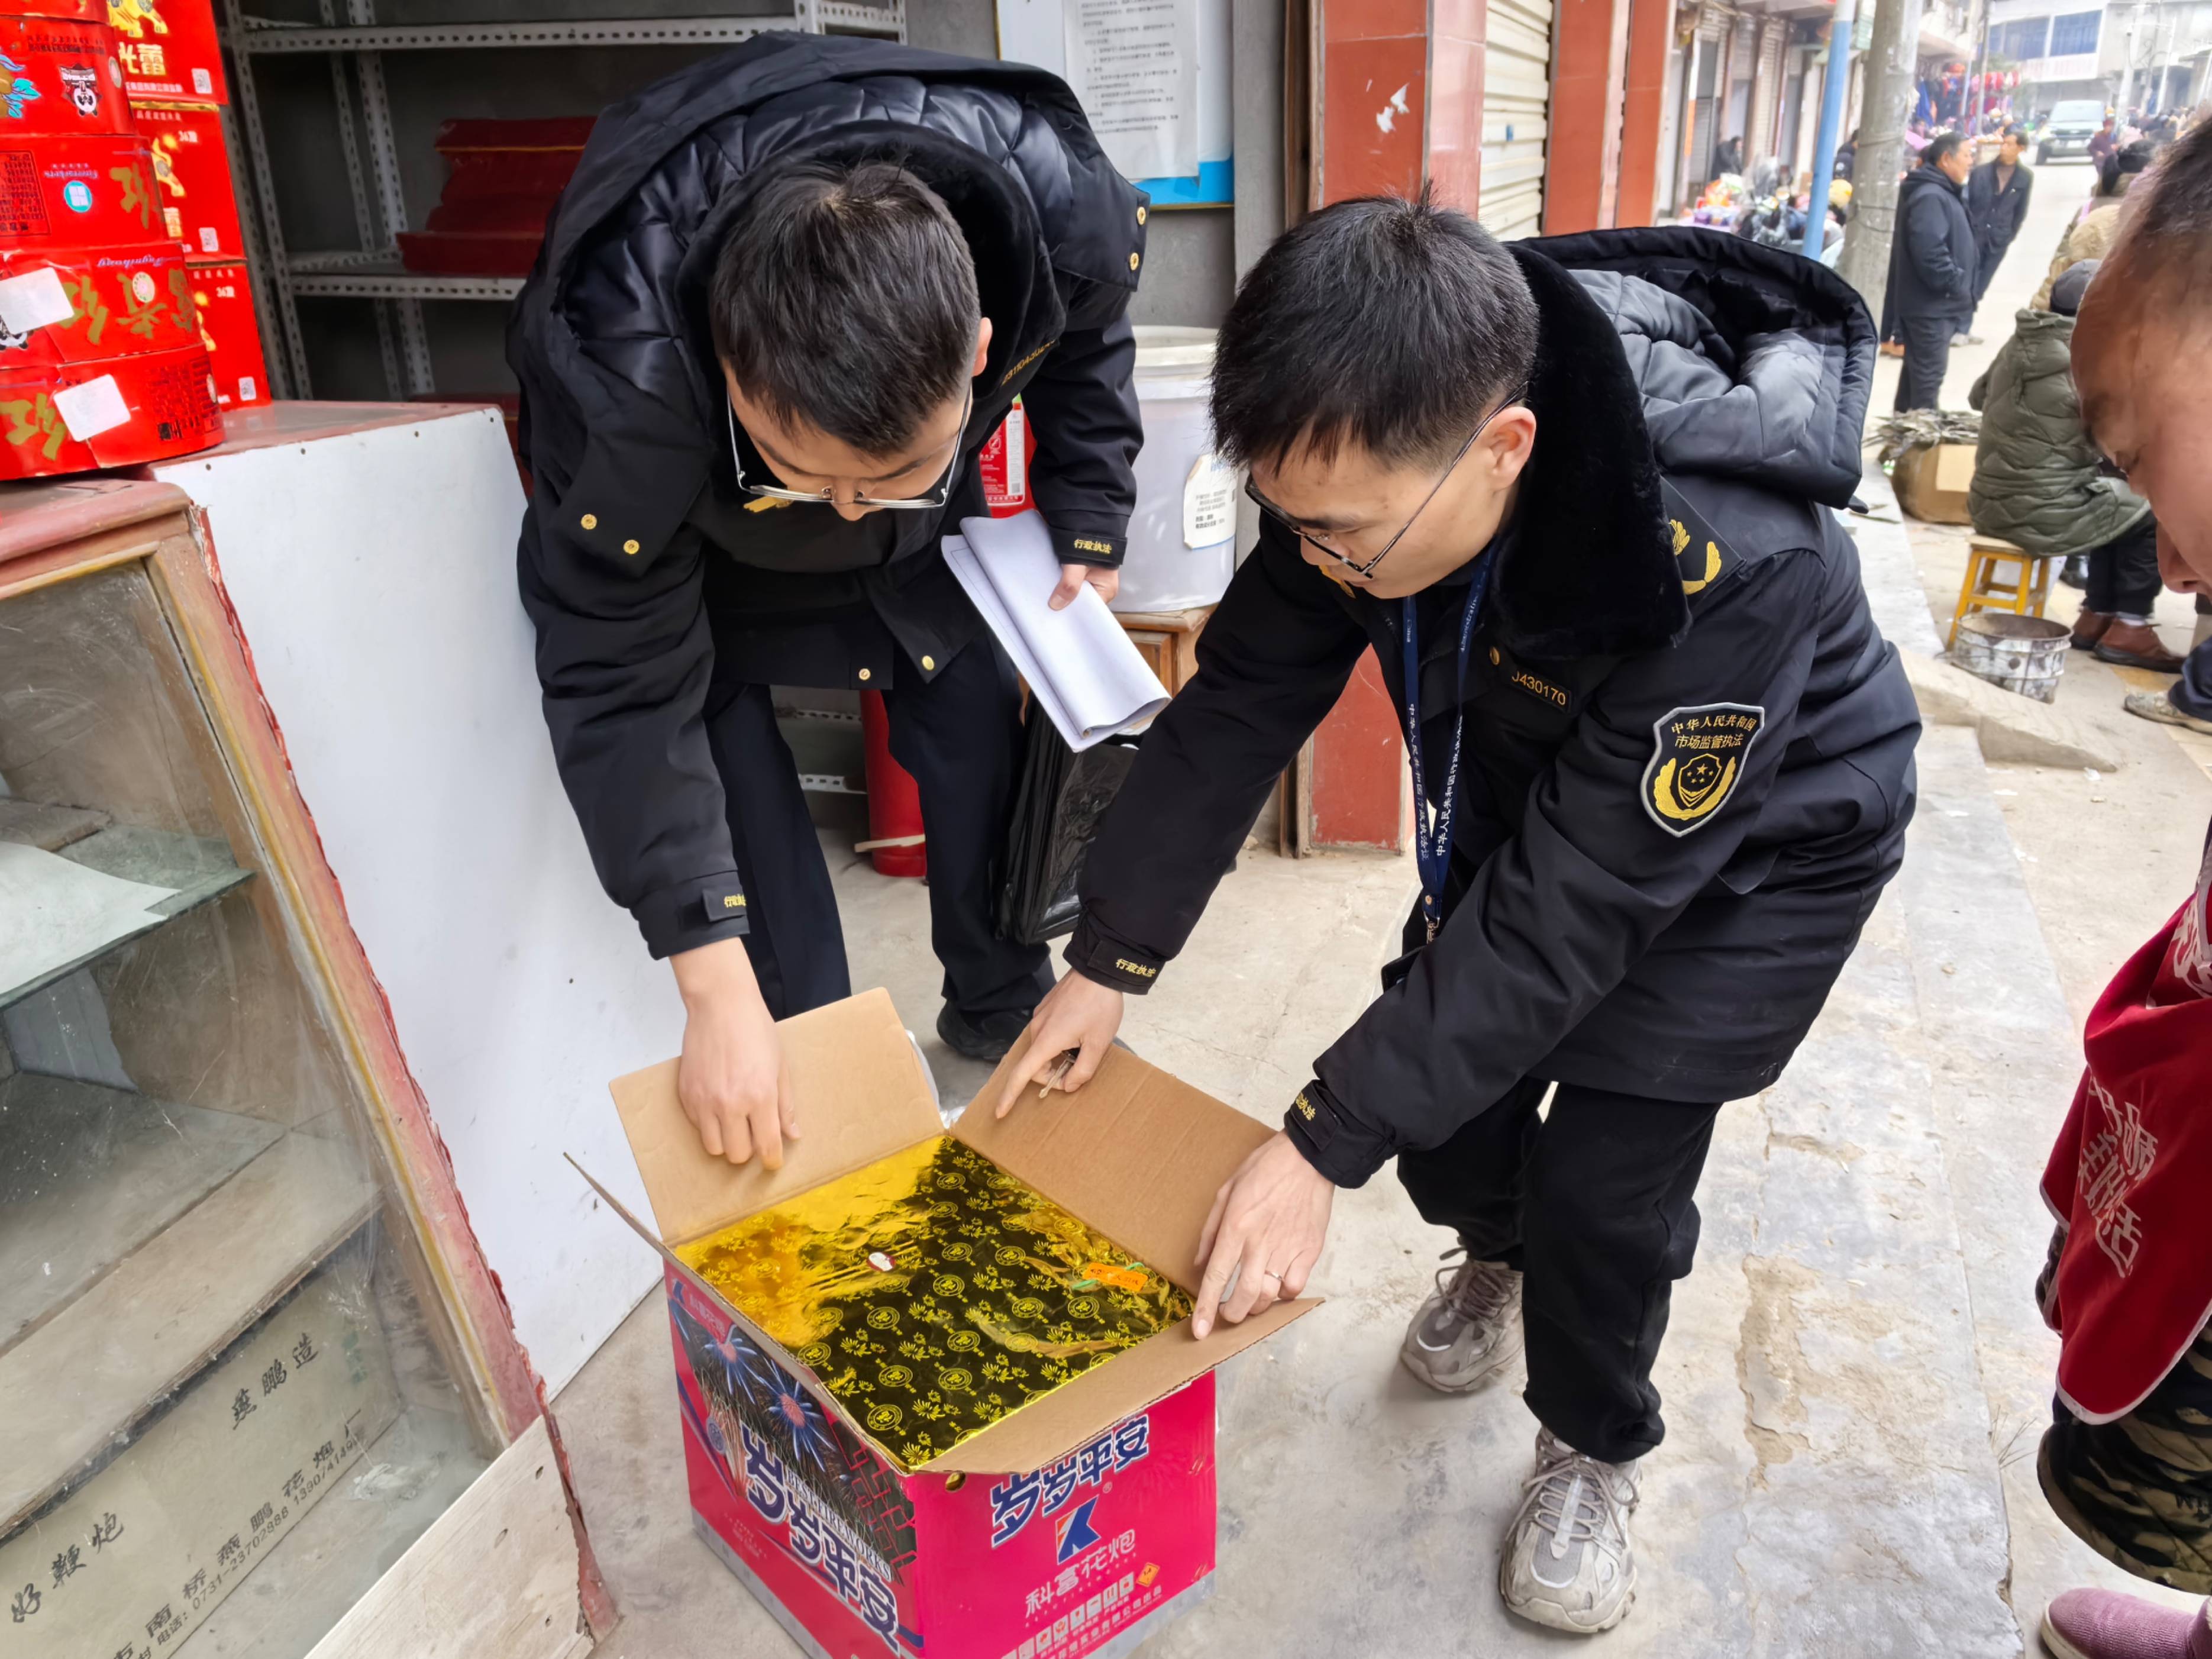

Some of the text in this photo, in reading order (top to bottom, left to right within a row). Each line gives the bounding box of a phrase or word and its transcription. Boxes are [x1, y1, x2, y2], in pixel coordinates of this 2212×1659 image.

[1074, 538, 1112, 554] 行政执法
[1512, 671, 1567, 705] J430170
[1671, 714, 1757, 735] 中华人民共和国
[1675, 732, 1743, 750] 市场监管执法
[989, 1413, 1149, 1550] 岁岁平安
[11, 1512, 124, 1622] 好鞭炮
[741, 1420, 900, 1657] 岁岁平安
[1025, 1528, 1136, 1618] 科富花炮
